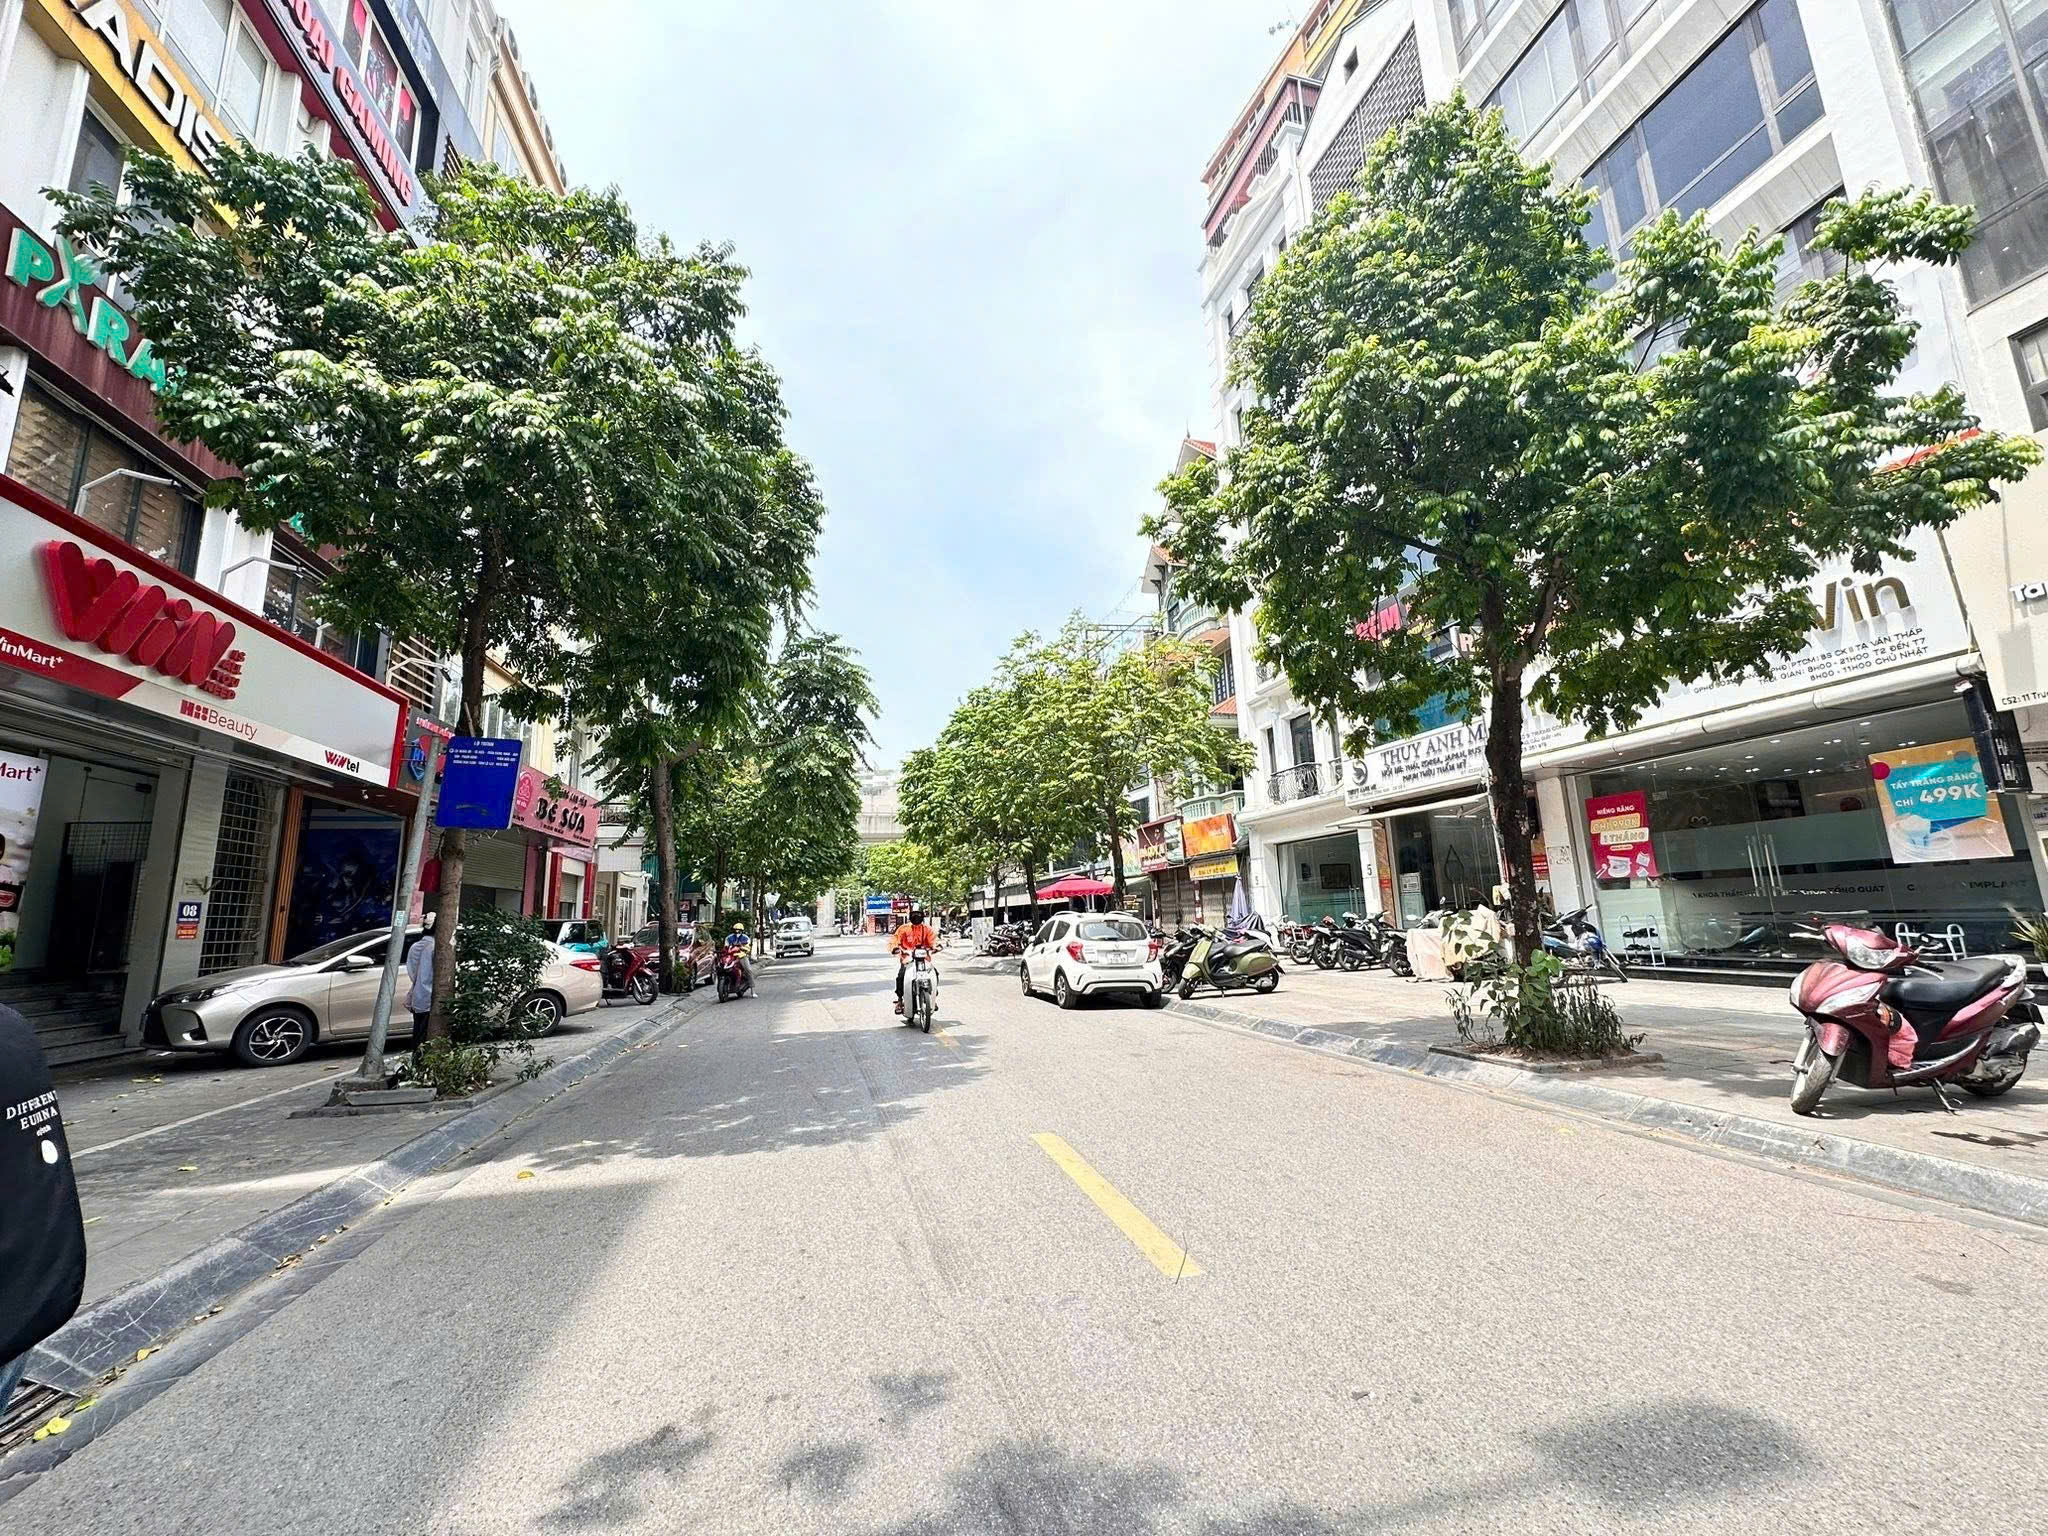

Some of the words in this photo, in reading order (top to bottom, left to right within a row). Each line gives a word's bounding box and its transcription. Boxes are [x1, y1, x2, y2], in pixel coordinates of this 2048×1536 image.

[333, 66, 412, 207] GAMING
[1821, 652, 1833, 661] BS
[1834, 648, 1848, 657] CK
[1873, 647, 1887, 656] T2
[1912, 636, 1926, 646] T7
[1426, 729, 1463, 756] ANH
[1919, 782, 1982, 804] 499K
[182, 904, 198, 917] 08
